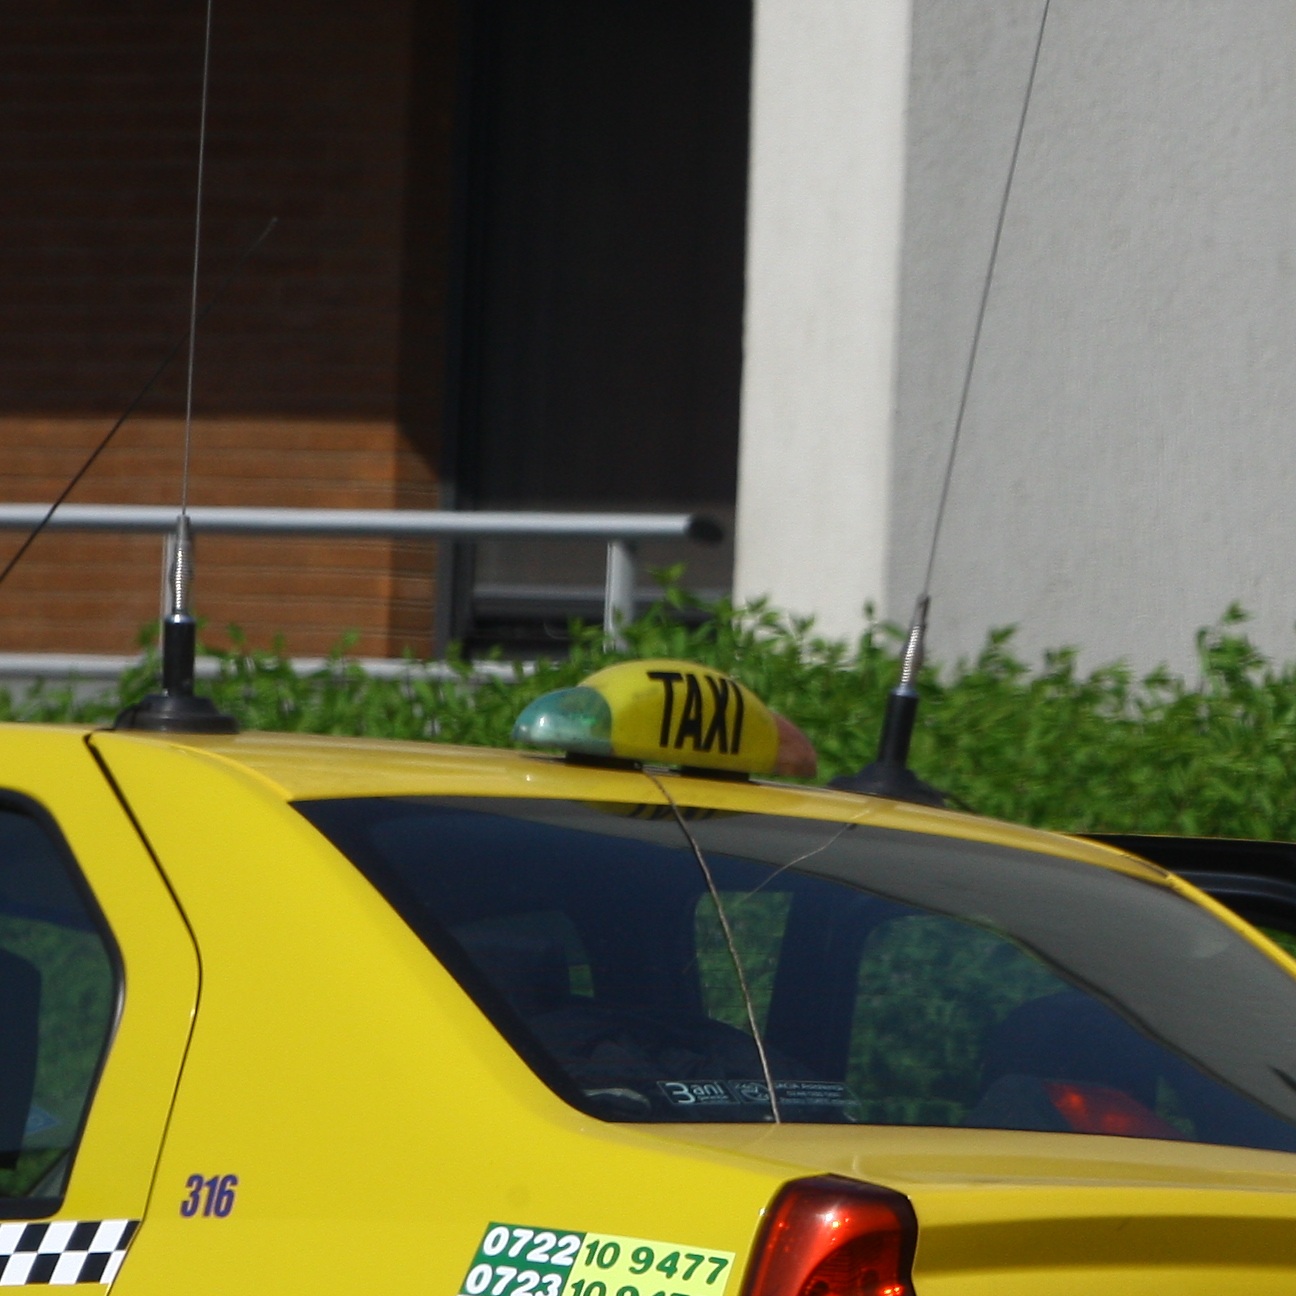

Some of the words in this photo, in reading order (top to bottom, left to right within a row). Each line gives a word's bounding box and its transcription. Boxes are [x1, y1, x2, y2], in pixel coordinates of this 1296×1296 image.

[647, 671, 744, 755] TAXI
[180, 1173, 239, 1218] 316
[483, 1225, 582, 1266] 0722
[585, 1240, 621, 1269] 10
[628, 1246, 729, 1285] 9477
